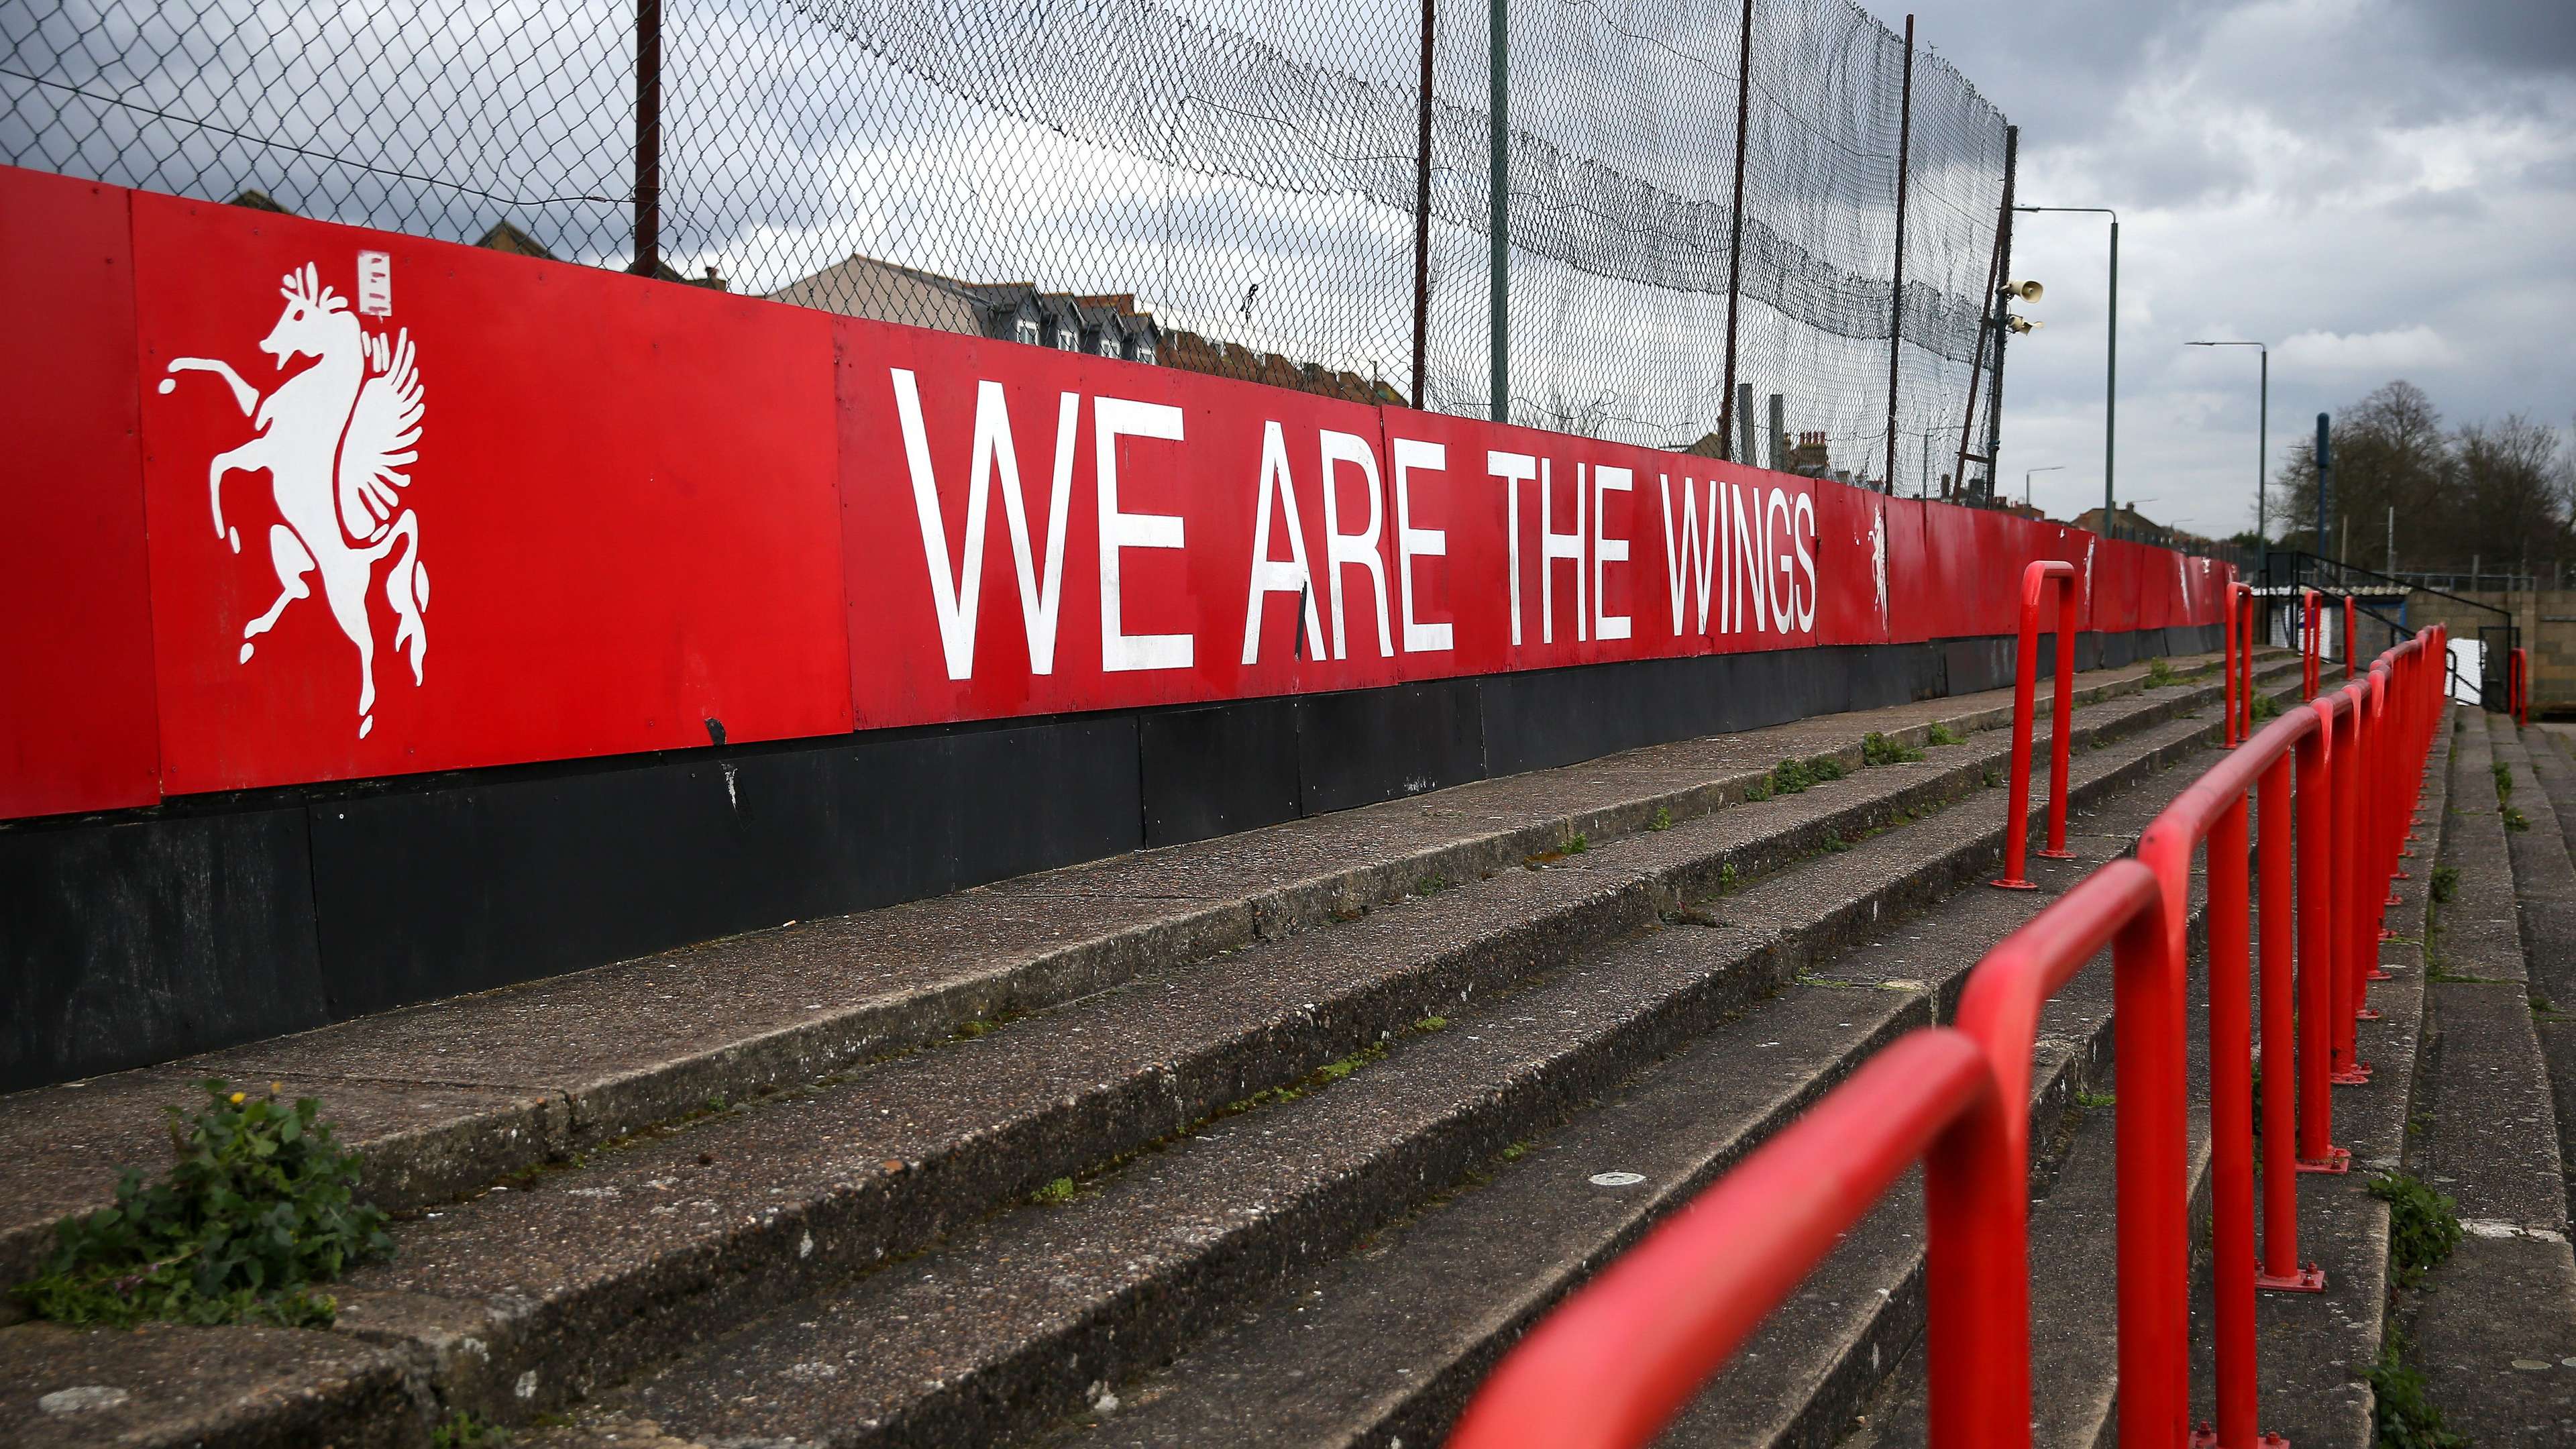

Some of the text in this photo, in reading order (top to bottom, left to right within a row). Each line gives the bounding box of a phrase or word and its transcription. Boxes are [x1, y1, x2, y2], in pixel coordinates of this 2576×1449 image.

[890, 368, 1816, 680] WE ARE THE WINGS
